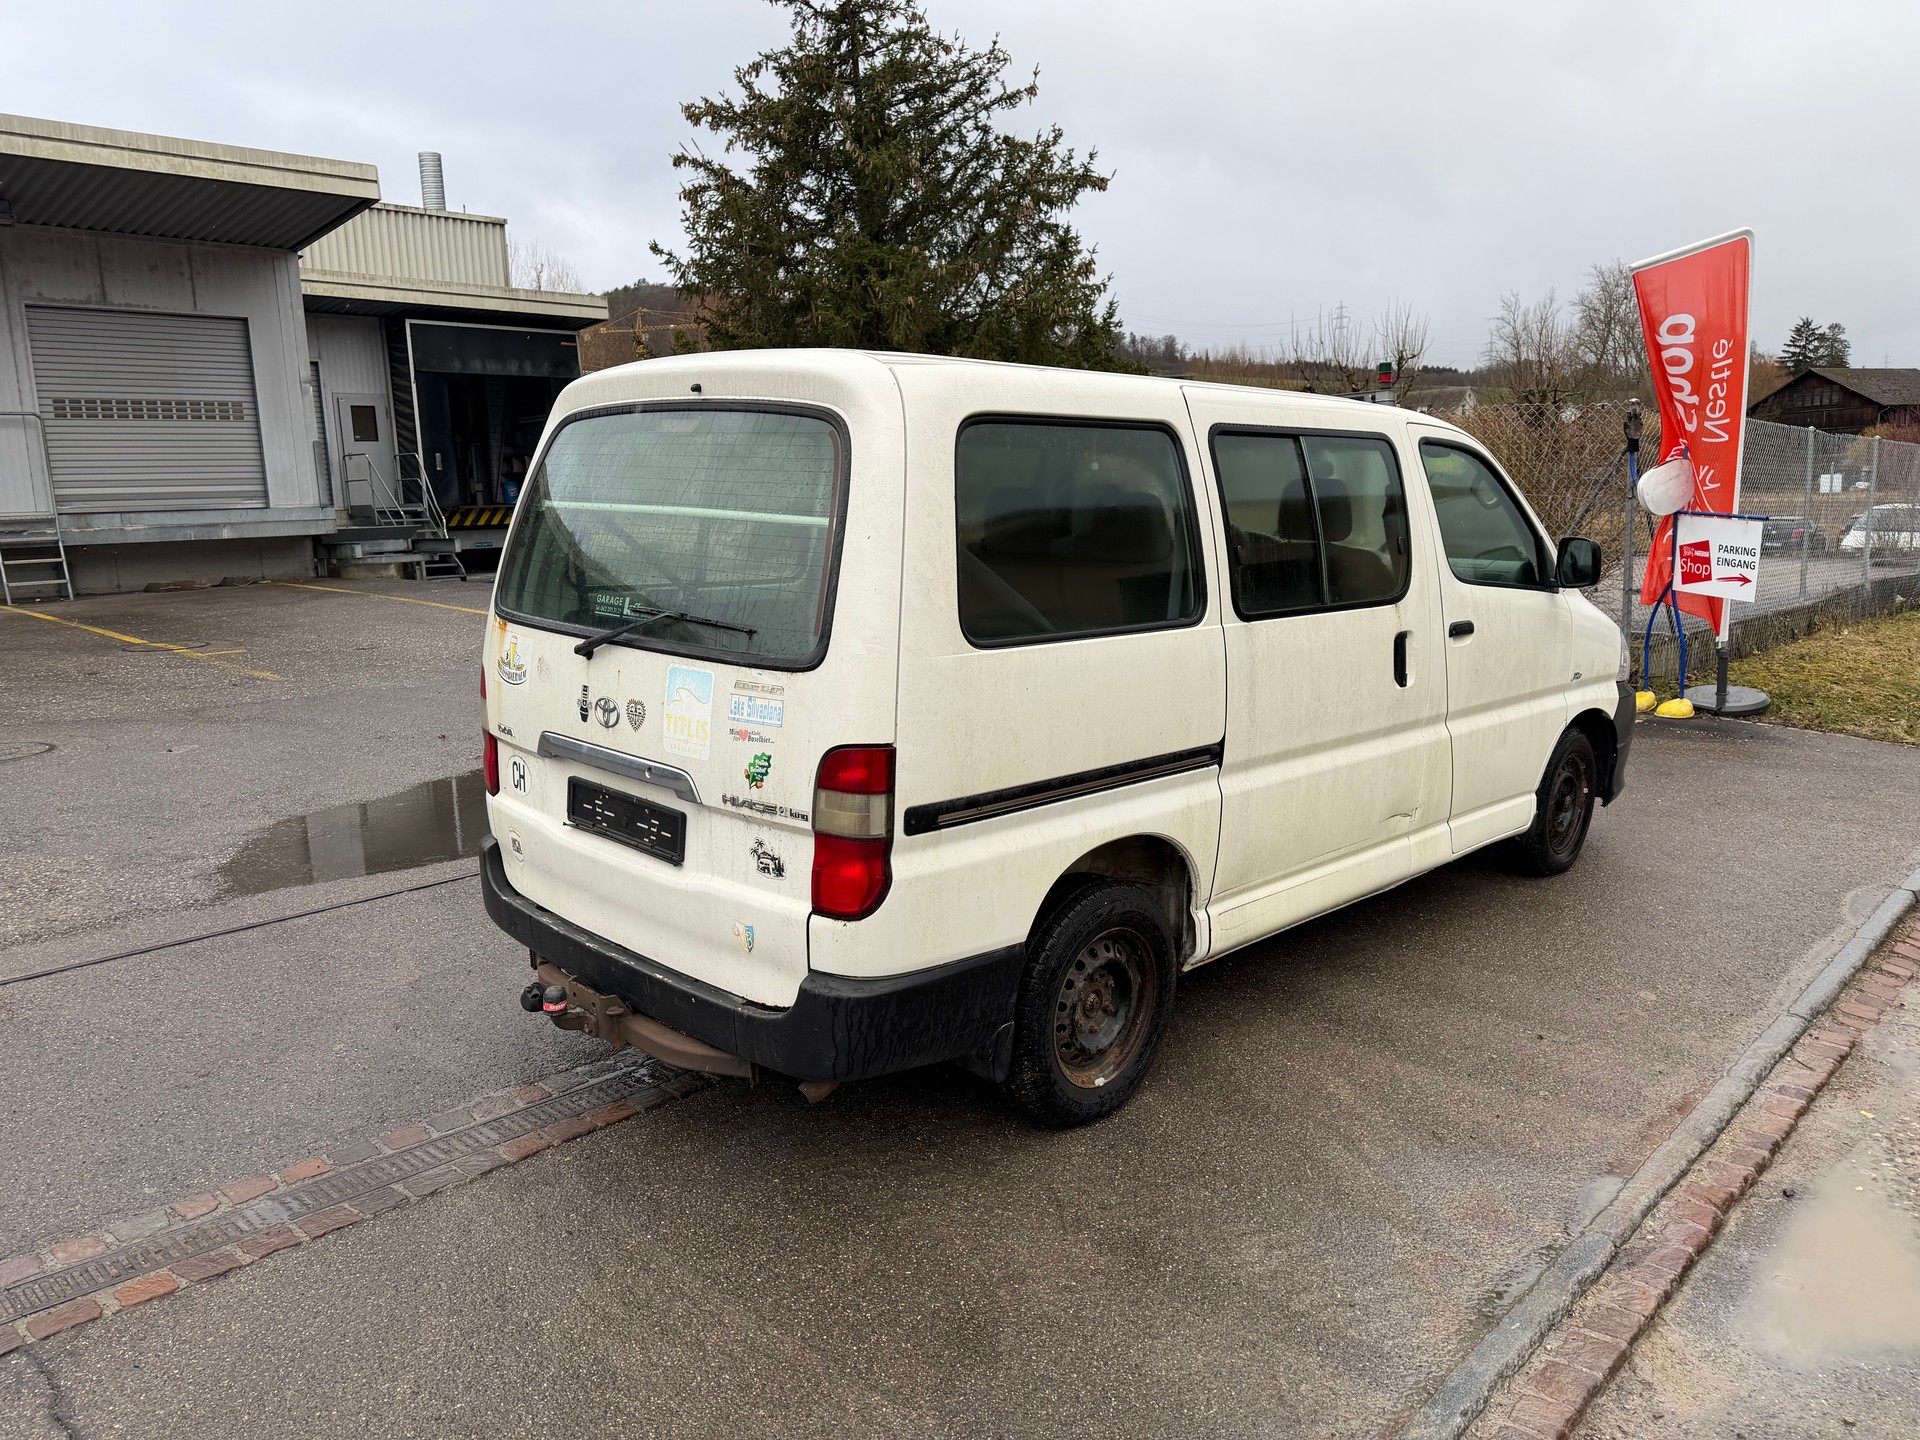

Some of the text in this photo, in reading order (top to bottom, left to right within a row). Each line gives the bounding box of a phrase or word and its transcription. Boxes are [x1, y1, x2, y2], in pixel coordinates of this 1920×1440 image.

[1718, 544, 1757, 557] PARKING
[1681, 557, 1710, 578] Shop
[1716, 557, 1756, 570] EINGANG
[596, 594, 623, 606] GARAGE
[729, 694, 745, 716] Lake
[665, 712, 709, 741] TITLIS
[512, 760, 526, 793] CH
[721, 793, 778, 816] HIACE
